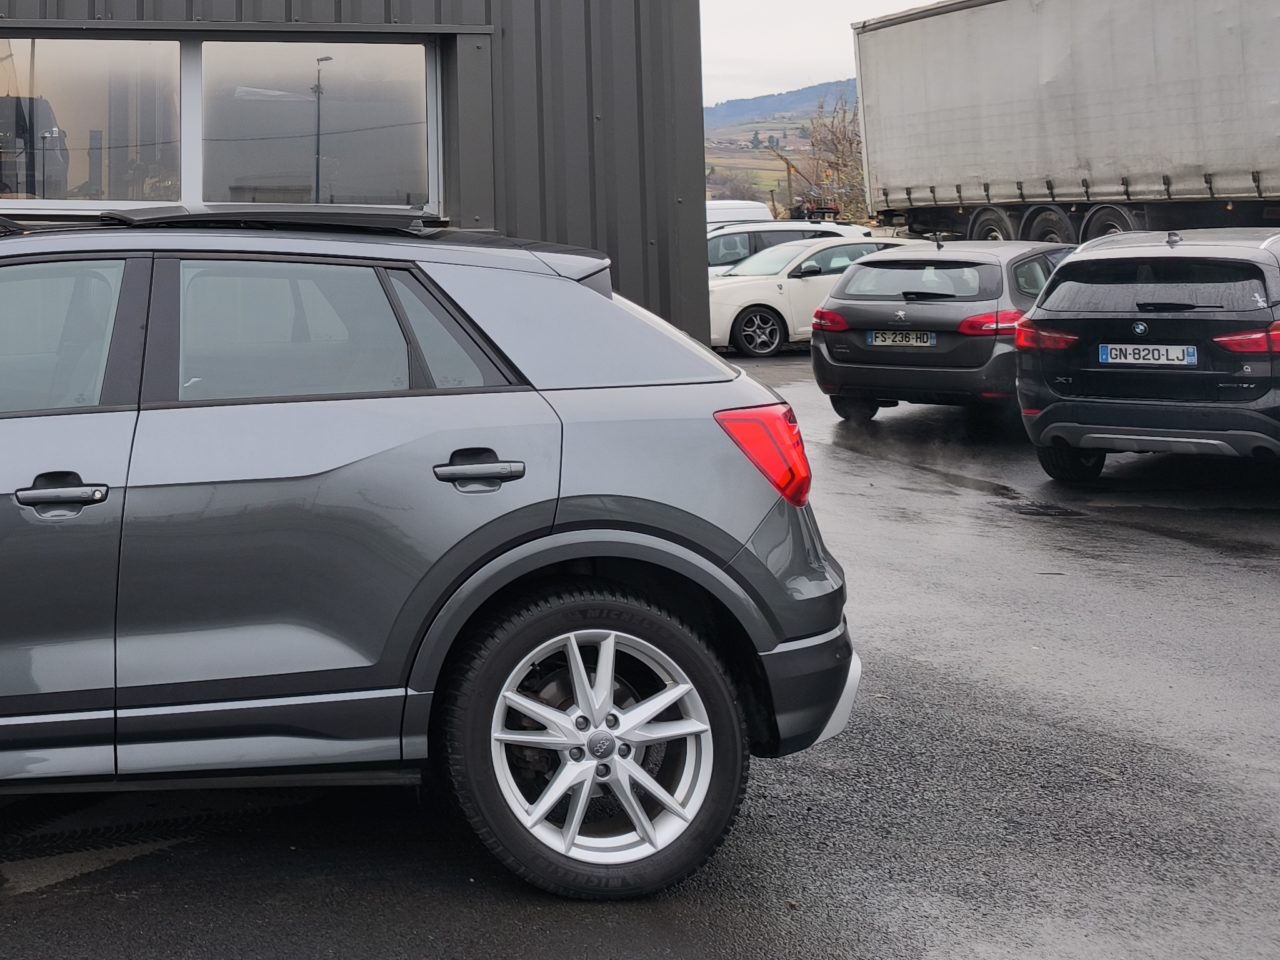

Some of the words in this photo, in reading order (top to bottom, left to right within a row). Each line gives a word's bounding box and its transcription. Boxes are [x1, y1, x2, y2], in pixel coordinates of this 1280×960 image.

[874, 332, 929, 344] FS-236-HD
[1109, 347, 1186, 362] GN-820-LJ
[586, 609, 664, 638] MICHEL
